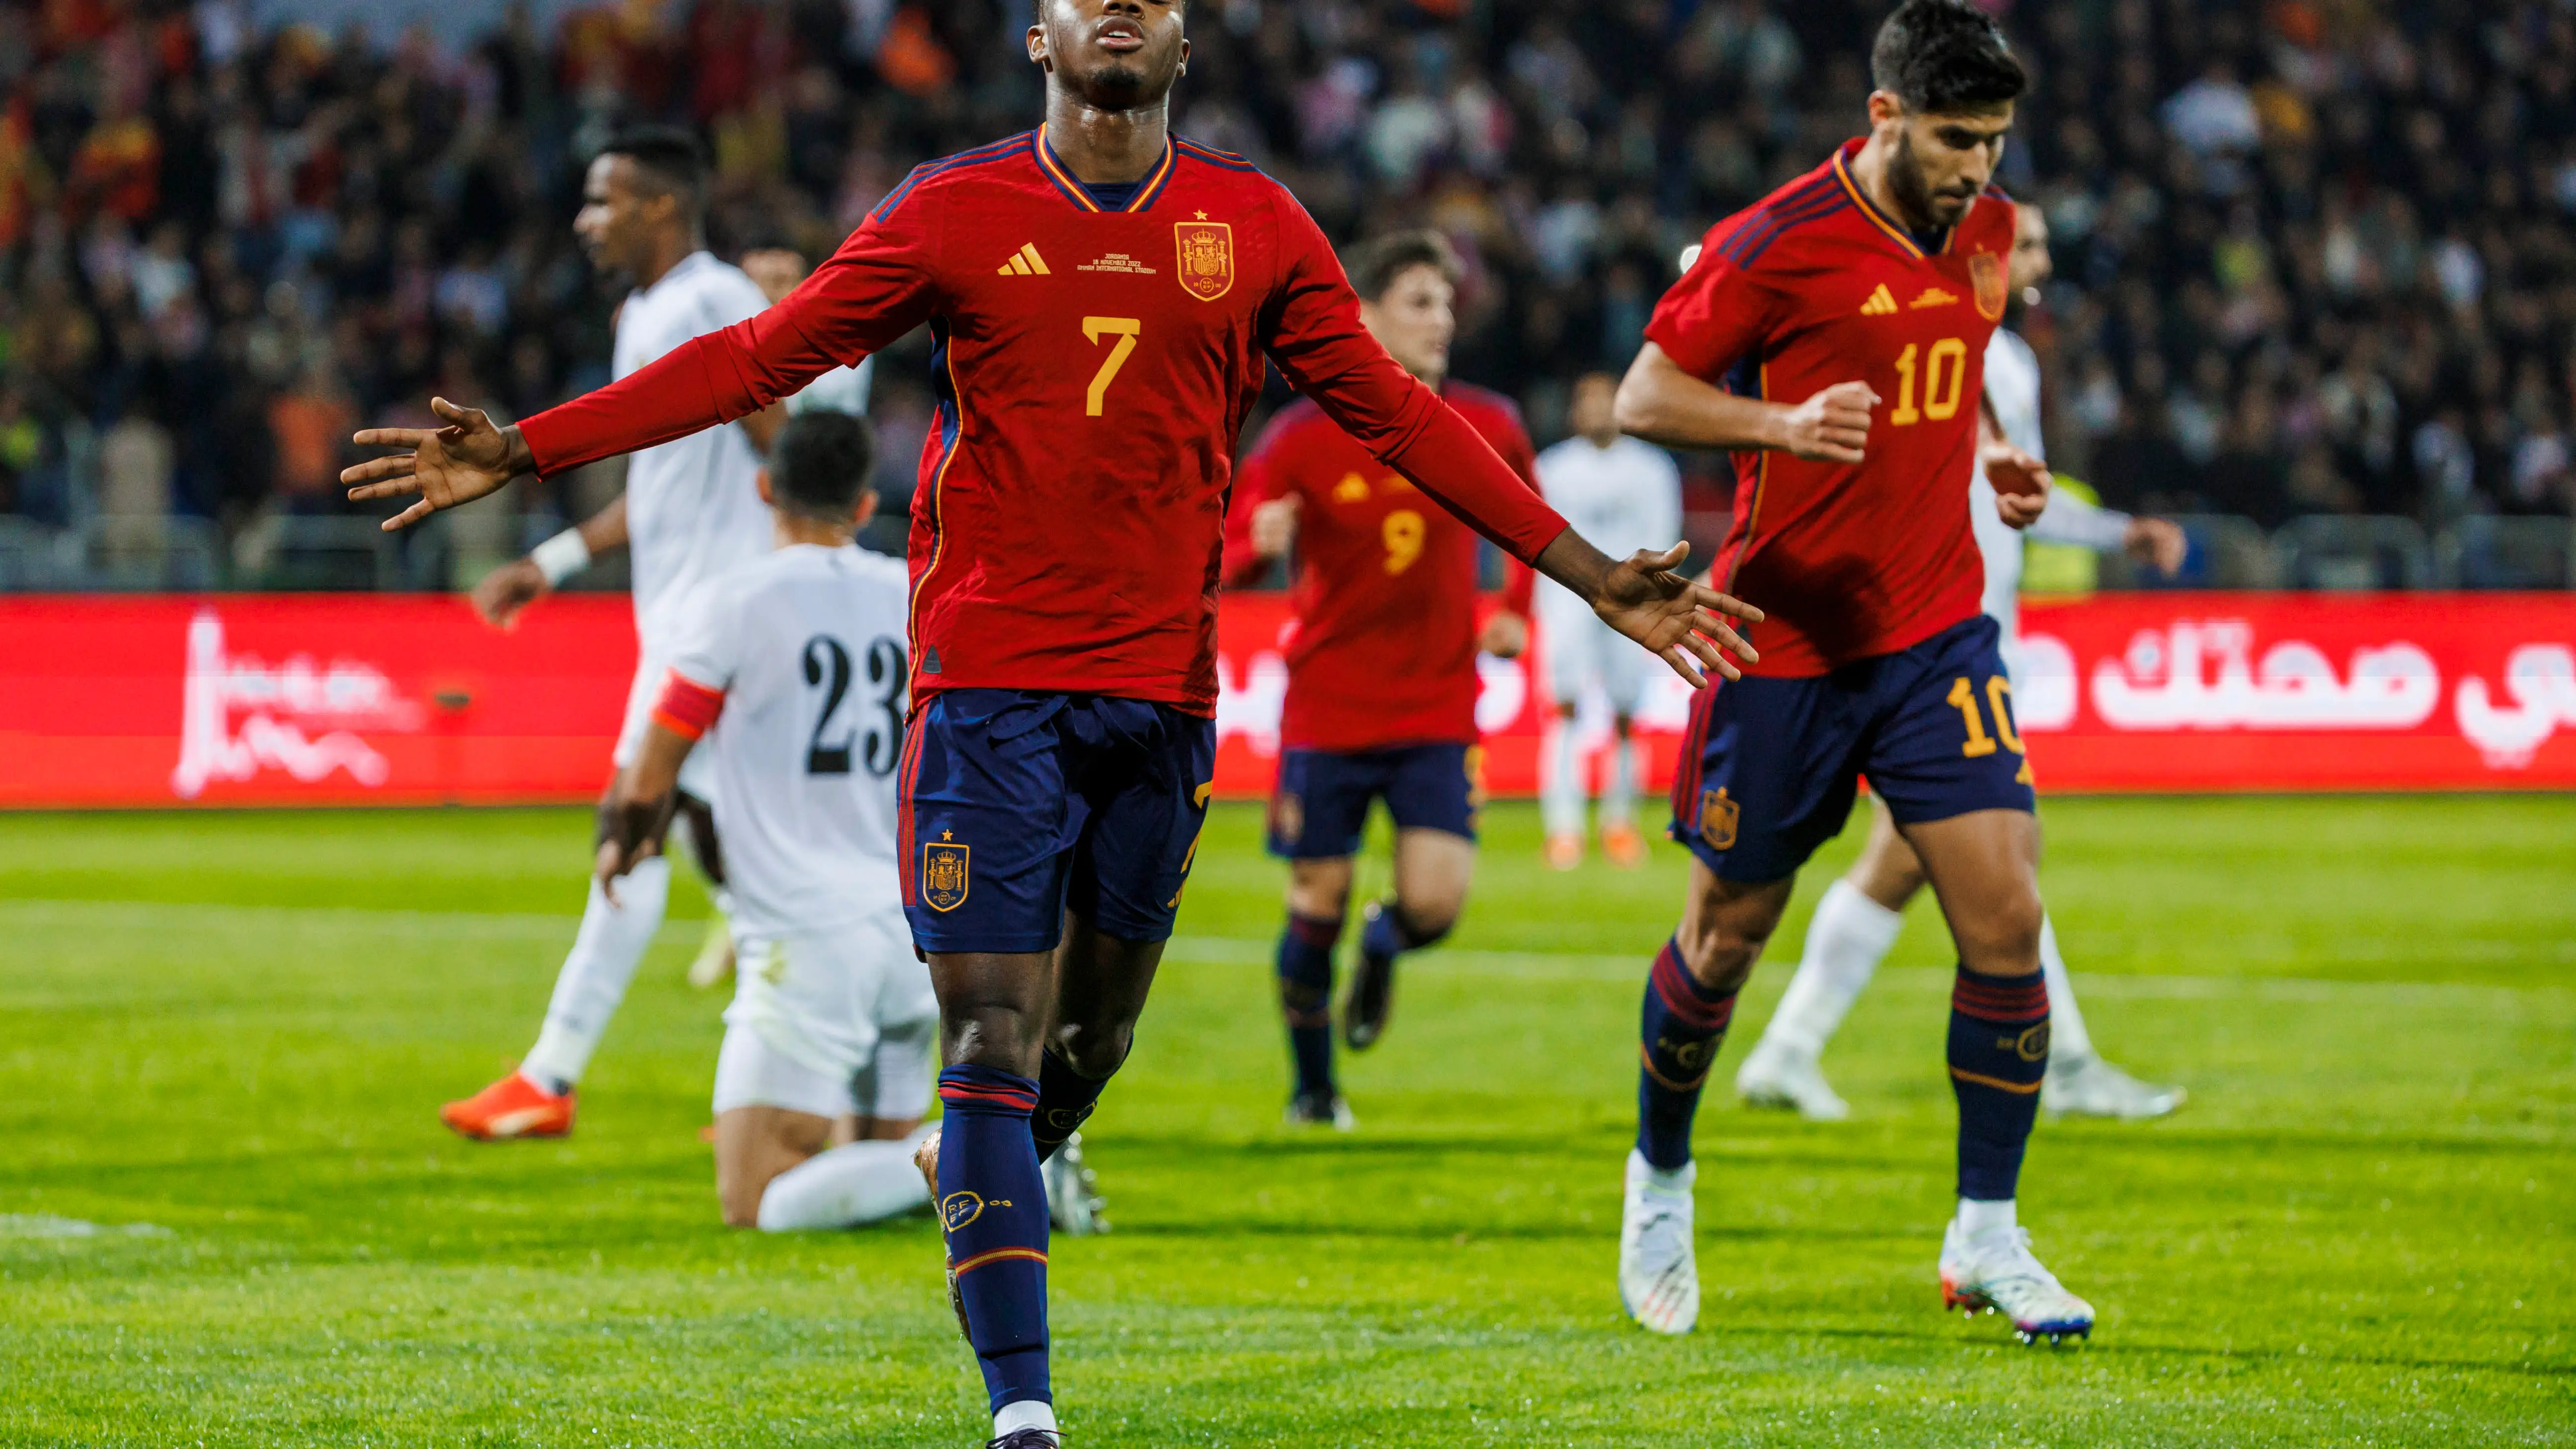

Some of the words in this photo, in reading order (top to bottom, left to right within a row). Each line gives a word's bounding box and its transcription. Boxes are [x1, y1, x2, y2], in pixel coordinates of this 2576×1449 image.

[1082, 316, 1141, 416] 7
[1890, 338, 1967, 427] 10
[1381, 509, 1427, 576] 9
[800, 632, 908, 777] 23
